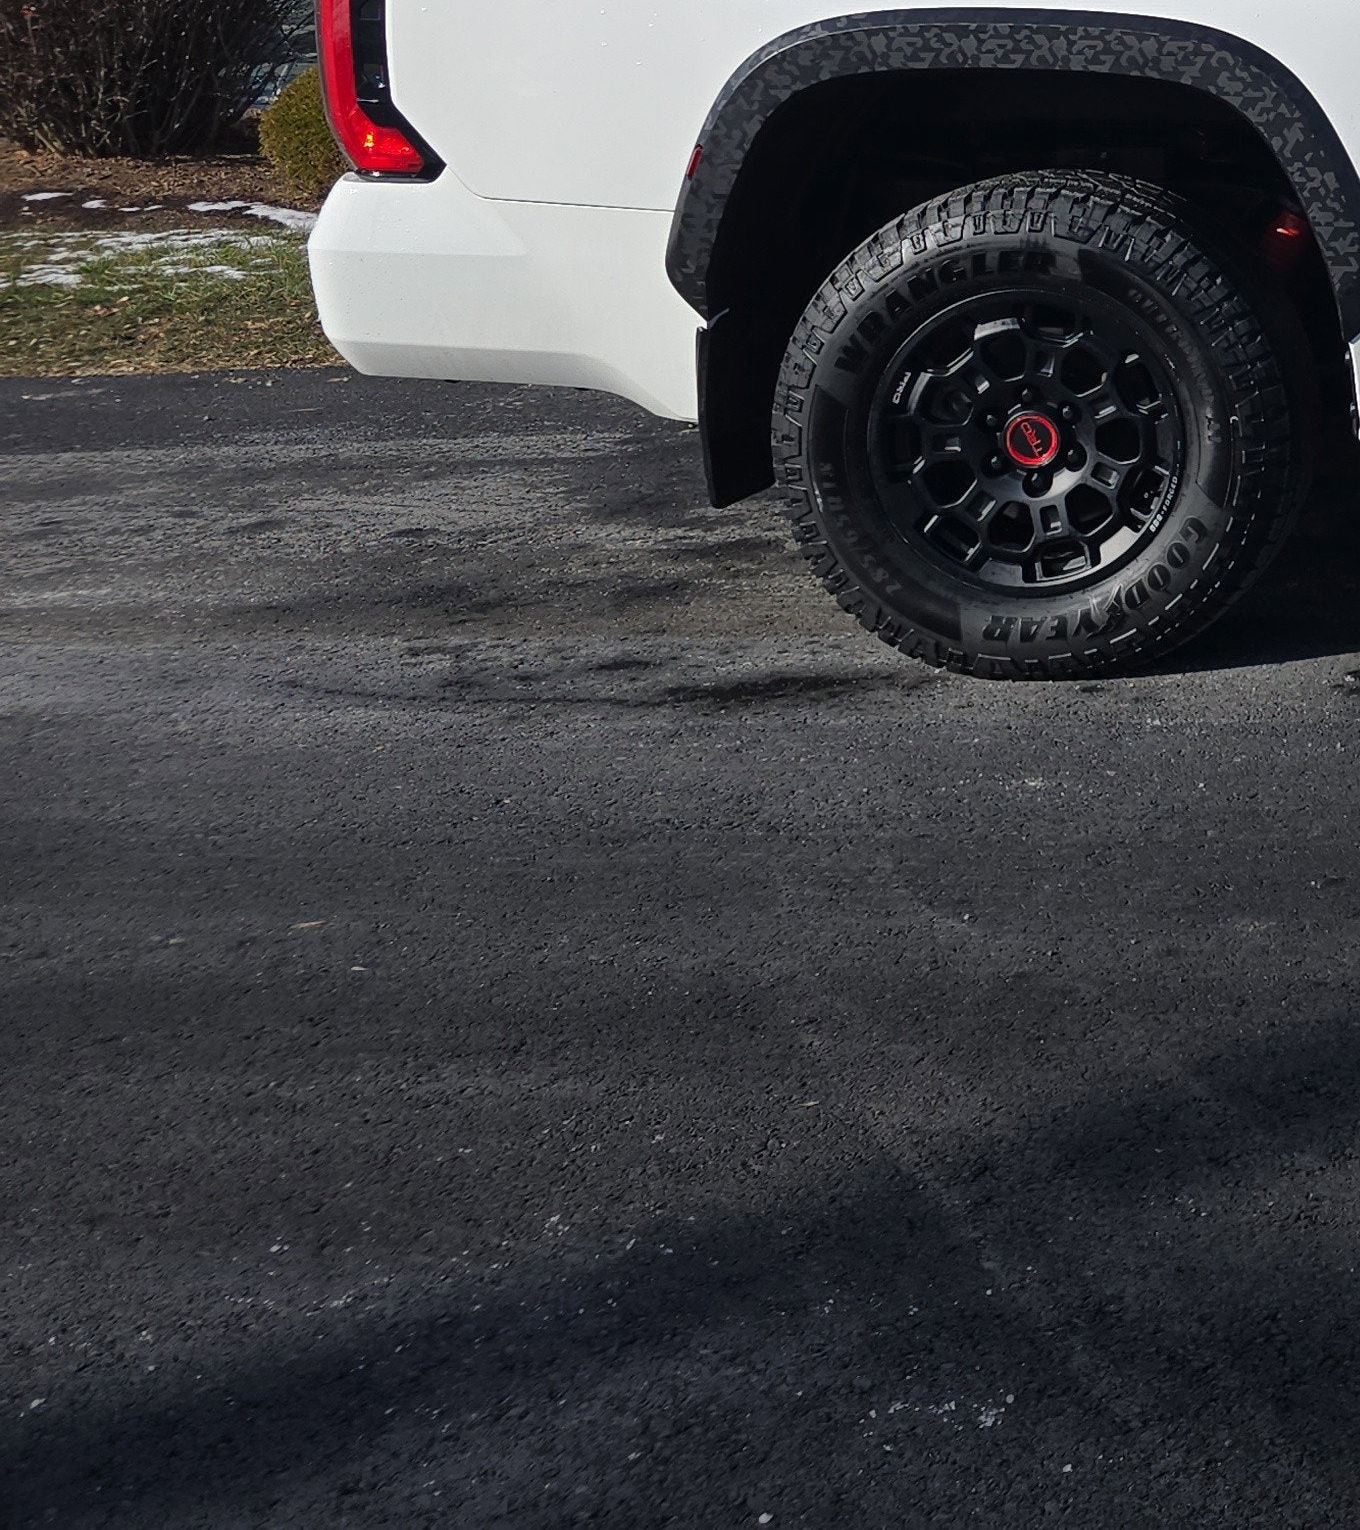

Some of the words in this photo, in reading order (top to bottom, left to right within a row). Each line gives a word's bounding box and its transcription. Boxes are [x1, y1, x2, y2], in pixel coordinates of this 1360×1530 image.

[834, 250, 1056, 374] WRANGLER
[1020, 421, 1043, 457] TRD
[982, 516, 1208, 642] GOODYEAR
